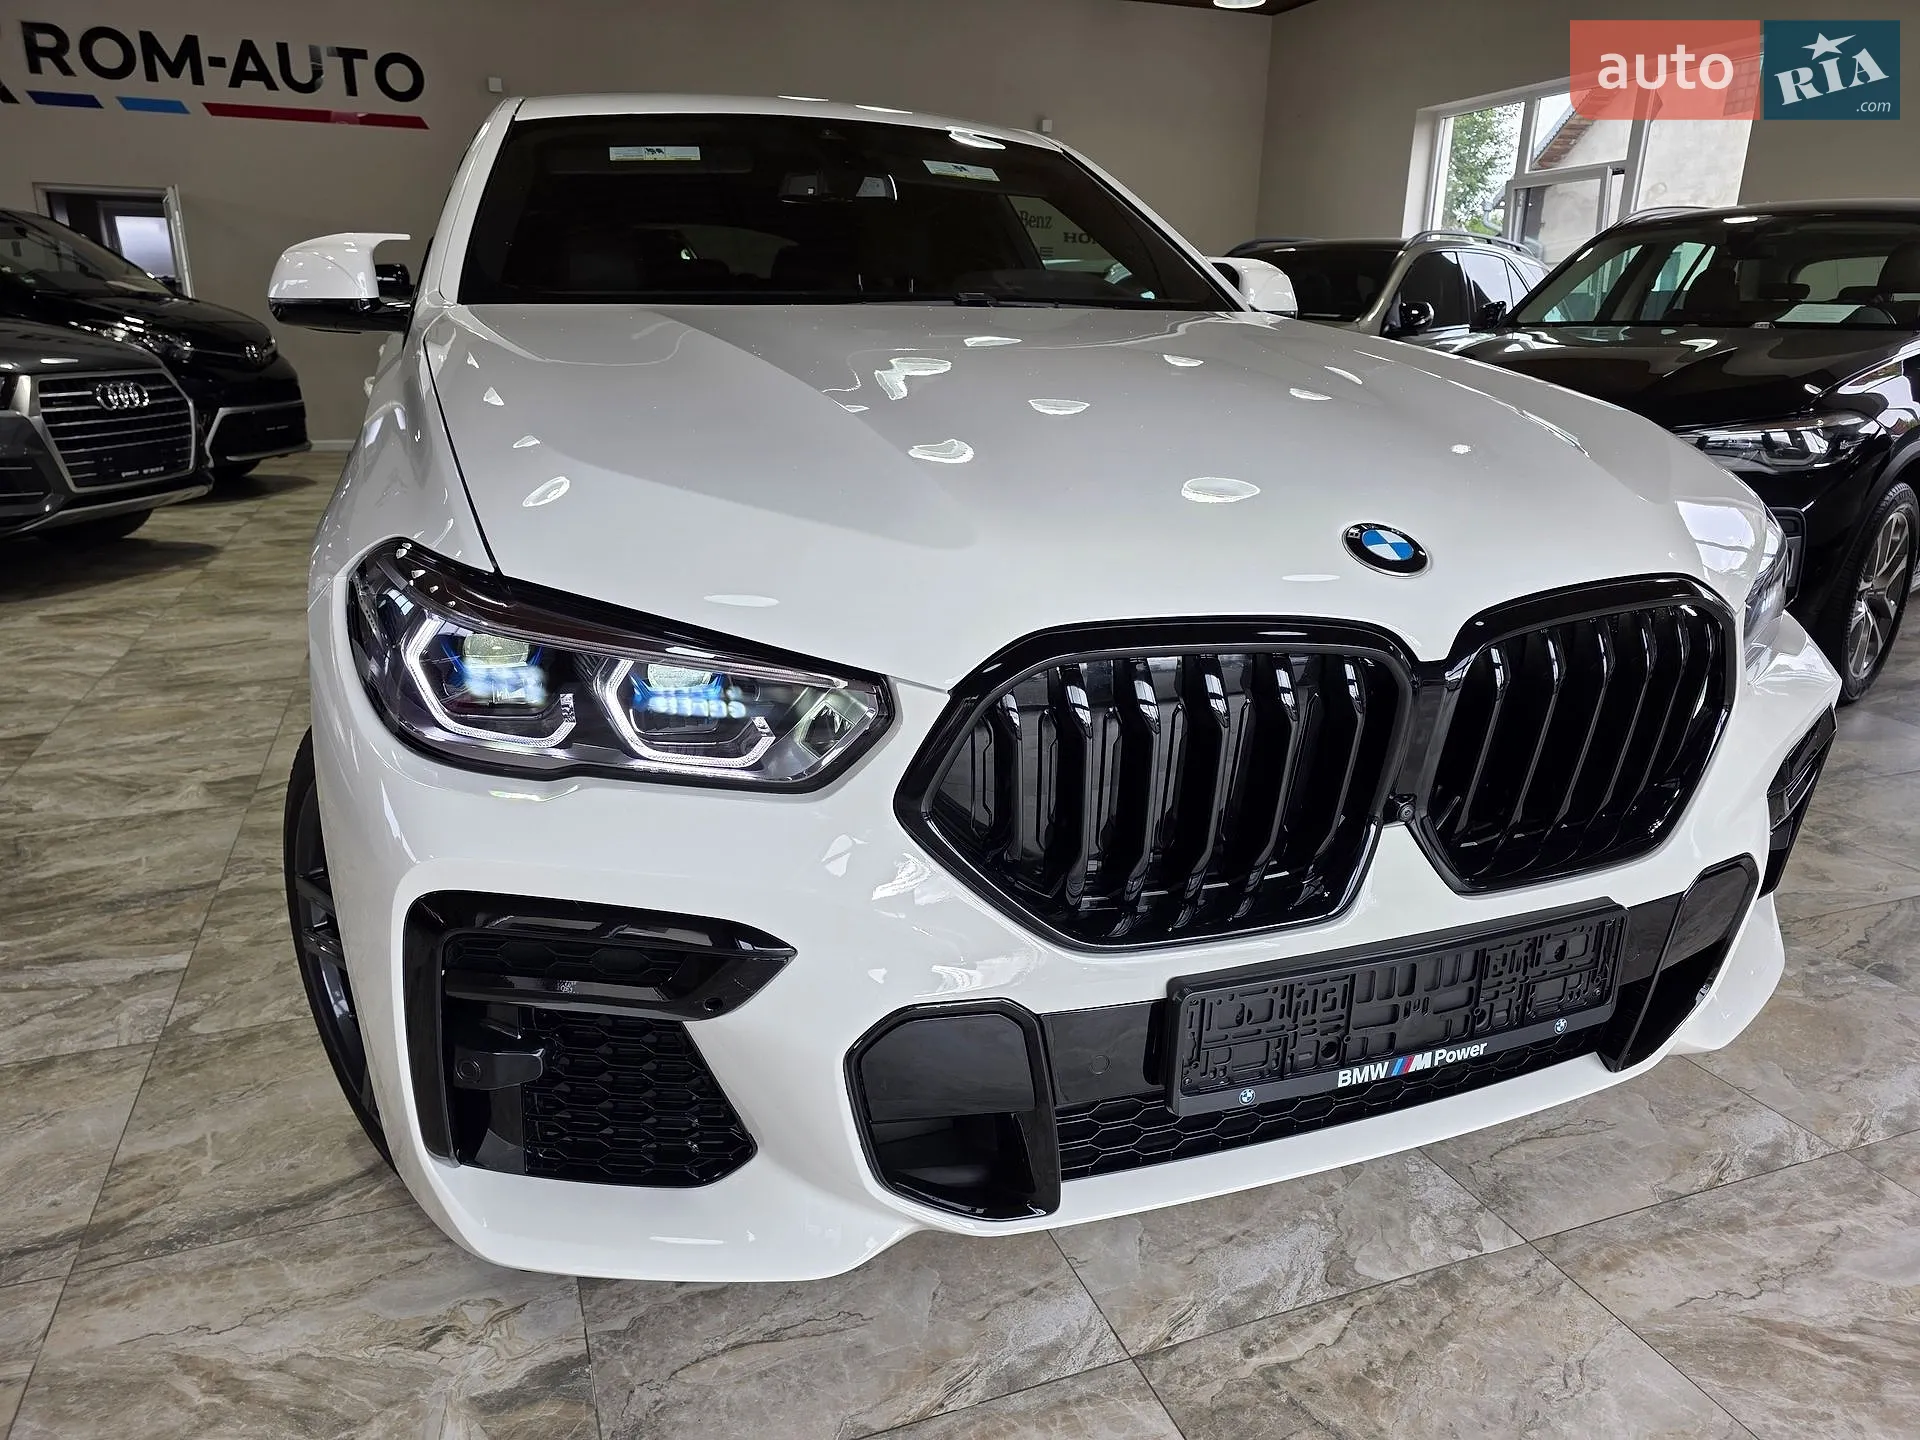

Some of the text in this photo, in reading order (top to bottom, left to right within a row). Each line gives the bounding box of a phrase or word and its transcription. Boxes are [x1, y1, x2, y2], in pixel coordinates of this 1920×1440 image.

[21, 21, 425, 102] ROM-AUTO
[1337, 1062, 1390, 1088] BMW
[1433, 1042, 1488, 1067] Power
